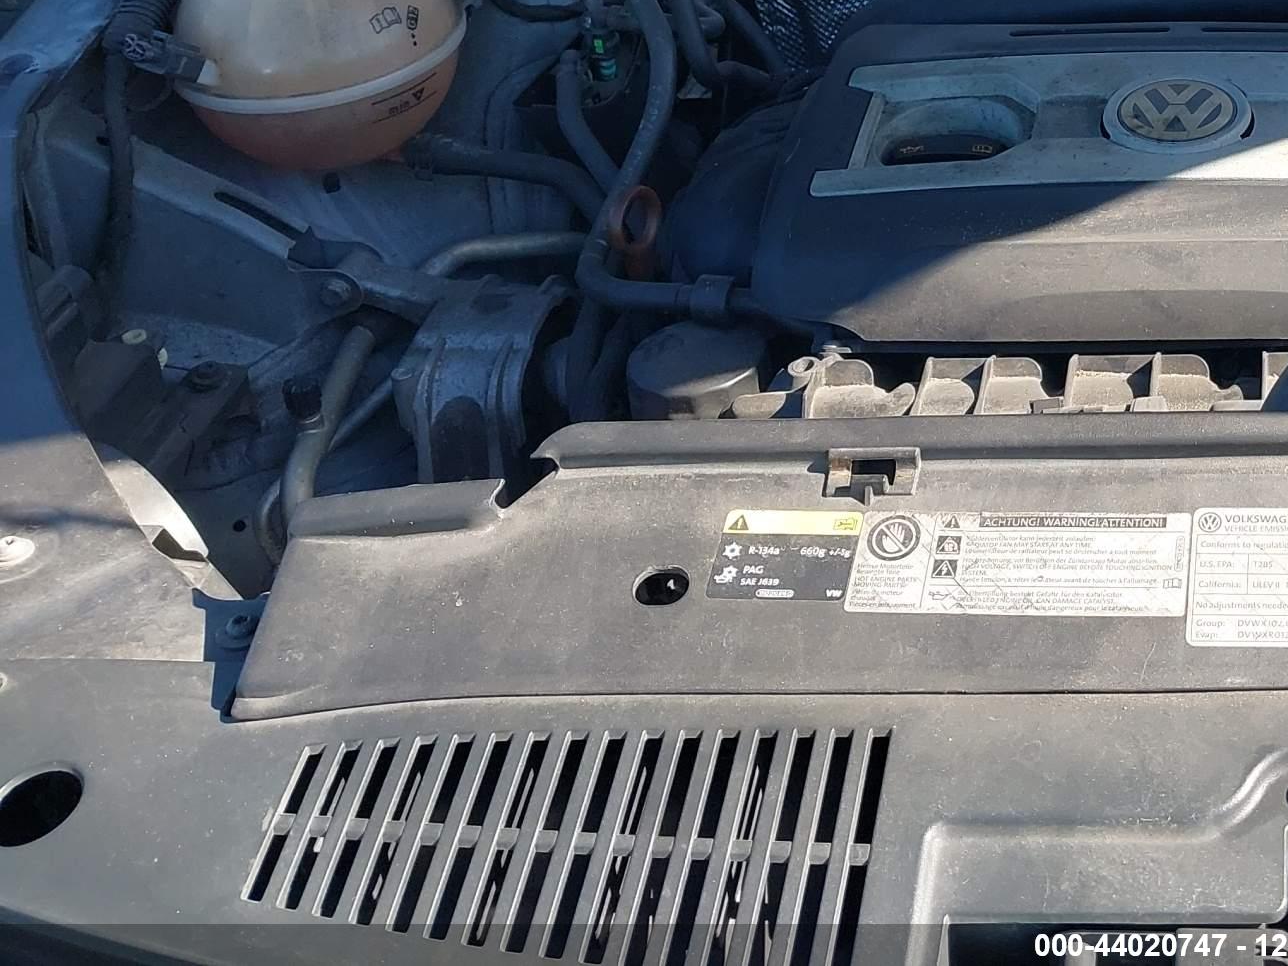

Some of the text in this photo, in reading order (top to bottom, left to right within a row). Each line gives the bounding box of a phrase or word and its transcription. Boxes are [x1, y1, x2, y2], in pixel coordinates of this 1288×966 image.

[983, 517, 1163, 527] ACHTUNG! WARNING! ATTENTION!
[748, 545, 780, 556] R-134a
[800, 546, 826, 557] 660g
[742, 565, 764, 574] PAG
[740, 577, 780, 586] SAE J639
[825, 589, 843, 598] VW
[1195, 601, 1207, 609] No
[1196, 619, 1226, 628] Group:
